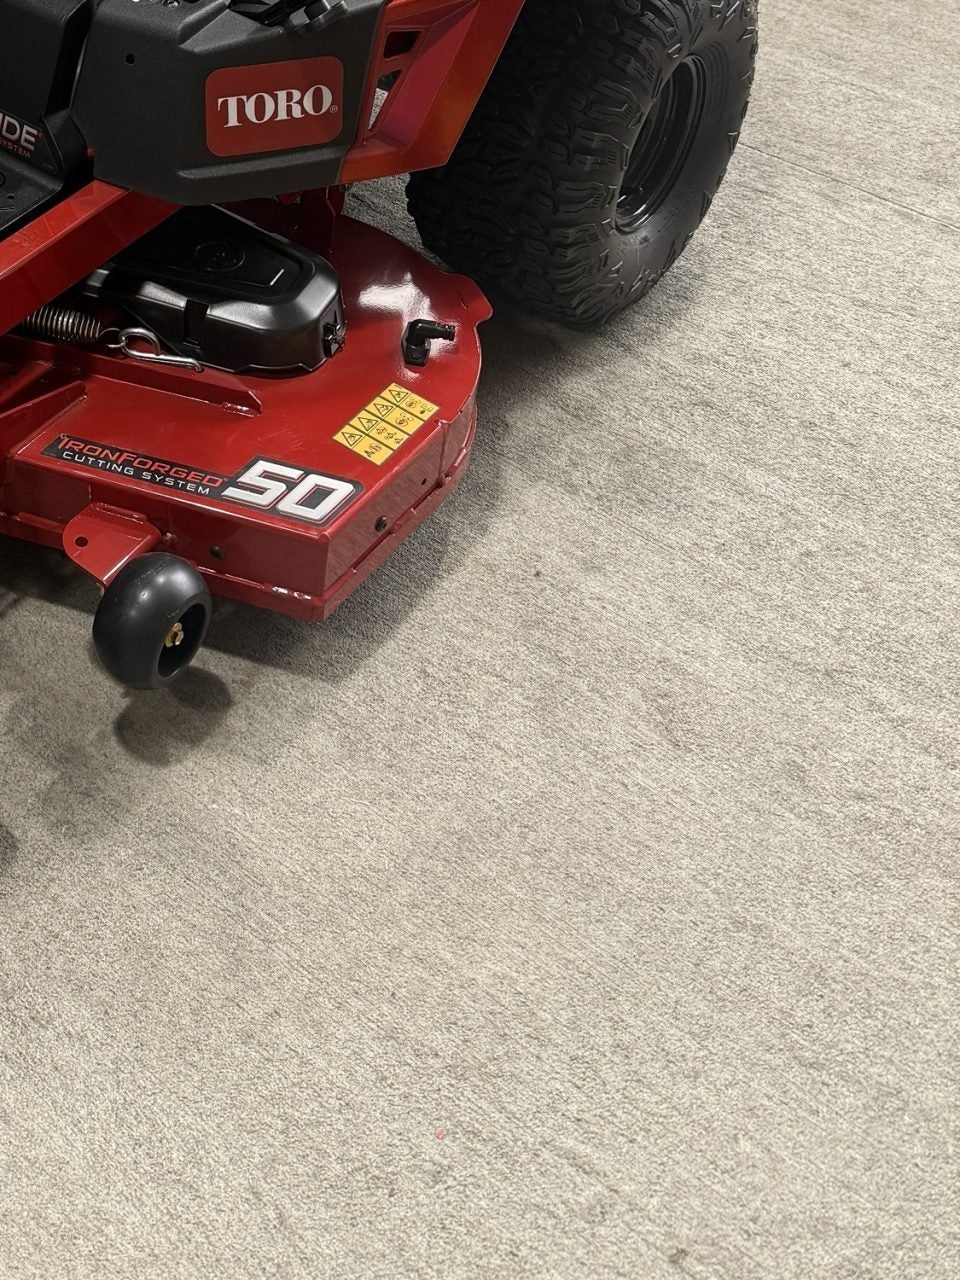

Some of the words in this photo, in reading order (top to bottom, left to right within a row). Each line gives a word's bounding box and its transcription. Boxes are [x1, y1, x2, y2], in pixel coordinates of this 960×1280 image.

[217, 84, 333, 128] TORO
[57, 435, 226, 488] IRONFORGED
[62, 450, 135, 476] CUTTING
[141, 470, 210, 495] SYSTEM
[221, 459, 356, 523] 50
